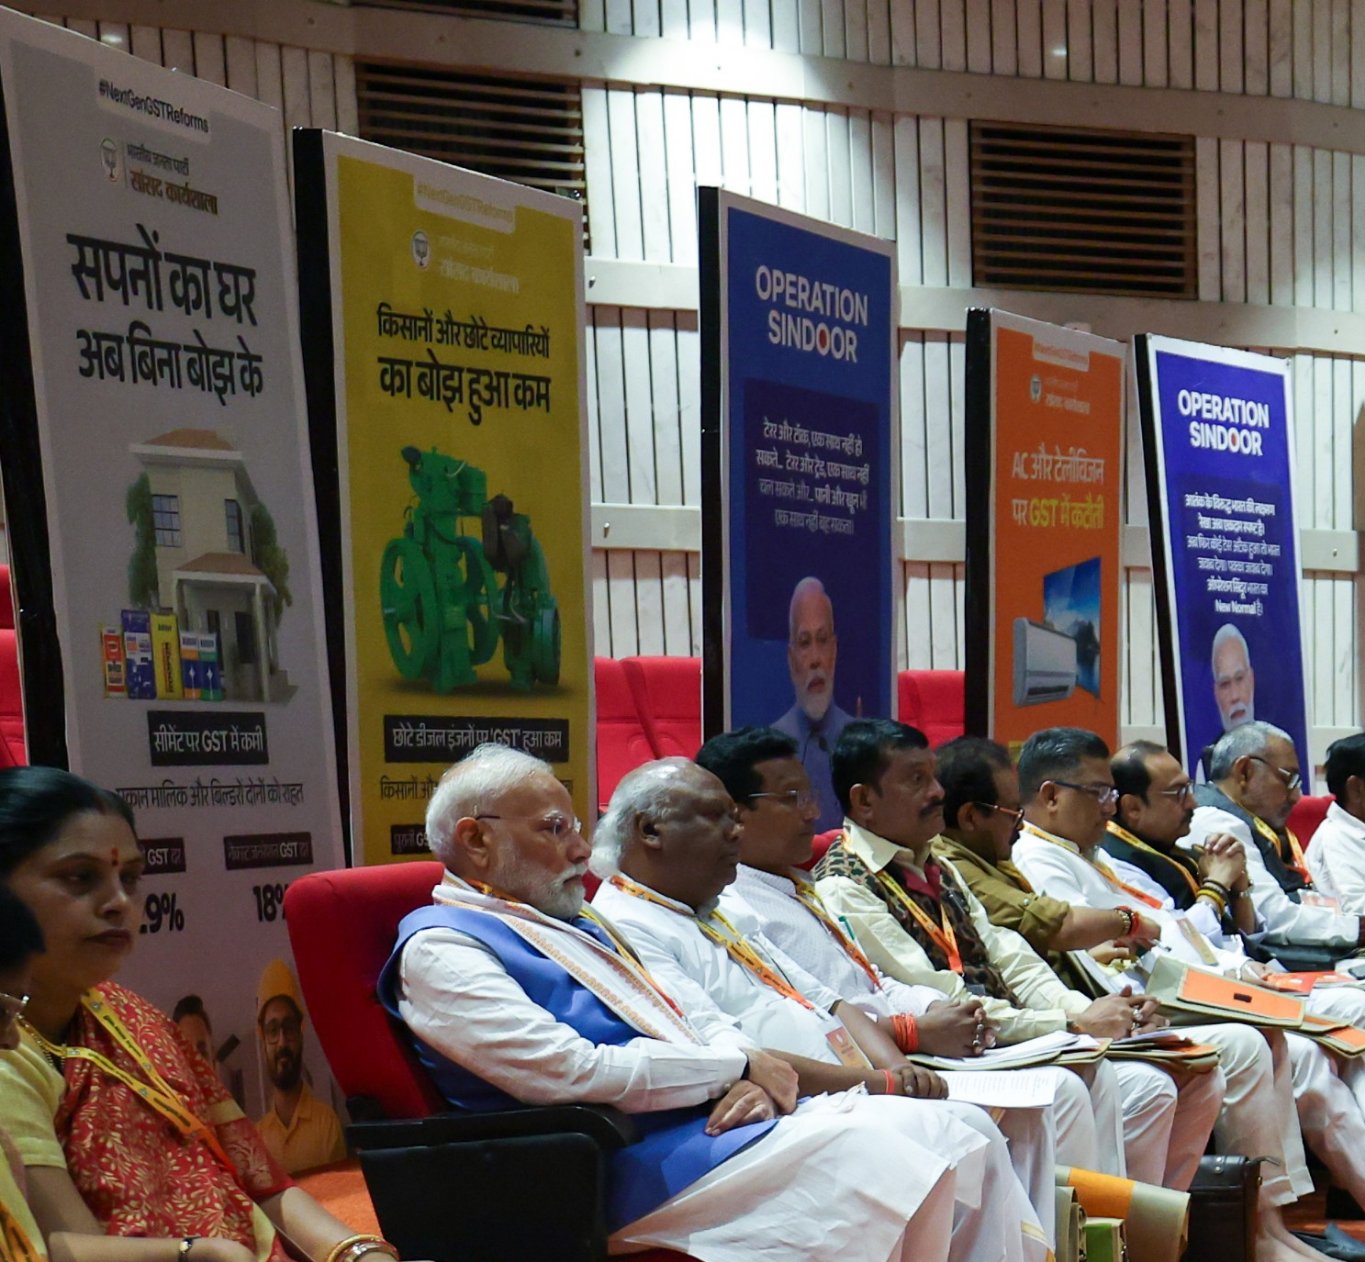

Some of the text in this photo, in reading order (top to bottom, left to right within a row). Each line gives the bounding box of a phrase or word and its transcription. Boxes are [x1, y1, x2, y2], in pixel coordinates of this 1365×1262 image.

[99, 78, 209, 133] #NextGenGSTReforms
[67, 223, 257, 326] सपनों का घर
[756, 265, 868, 326] OPERATION
[377, 302, 549, 359] किसानों और छोटे व्यापारियों
[769, 309, 858, 363] SINDOOR
[77, 320, 263, 406] अब बिना बोझ के
[378, 348, 551, 426] का बोझ हुआ कम
[1178, 389, 1269, 428] OPERATION
[1189, 421, 1263, 456] SINDOOR
[1012, 452, 1029, 480] AC
[1031, 443, 1052, 480] और
[1012, 493, 1105, 528] पर GST में कटौती
[154, 724, 263, 752] सीमेंट पर GST में कमी
[393, 721, 413, 747] छोटे
[416, 723, 445, 747] डीजल
[448, 724, 474, 750] इंजनों
[523, 731, 542, 750] हुआ
[544, 730, 562, 747] कम
[150, 779, 188, 809] मालिक
[190, 776, 209, 806] और
[380, 773, 417, 800] किसानों
[148, 848, 170, 865] GST
[280, 842, 298, 858] GST
